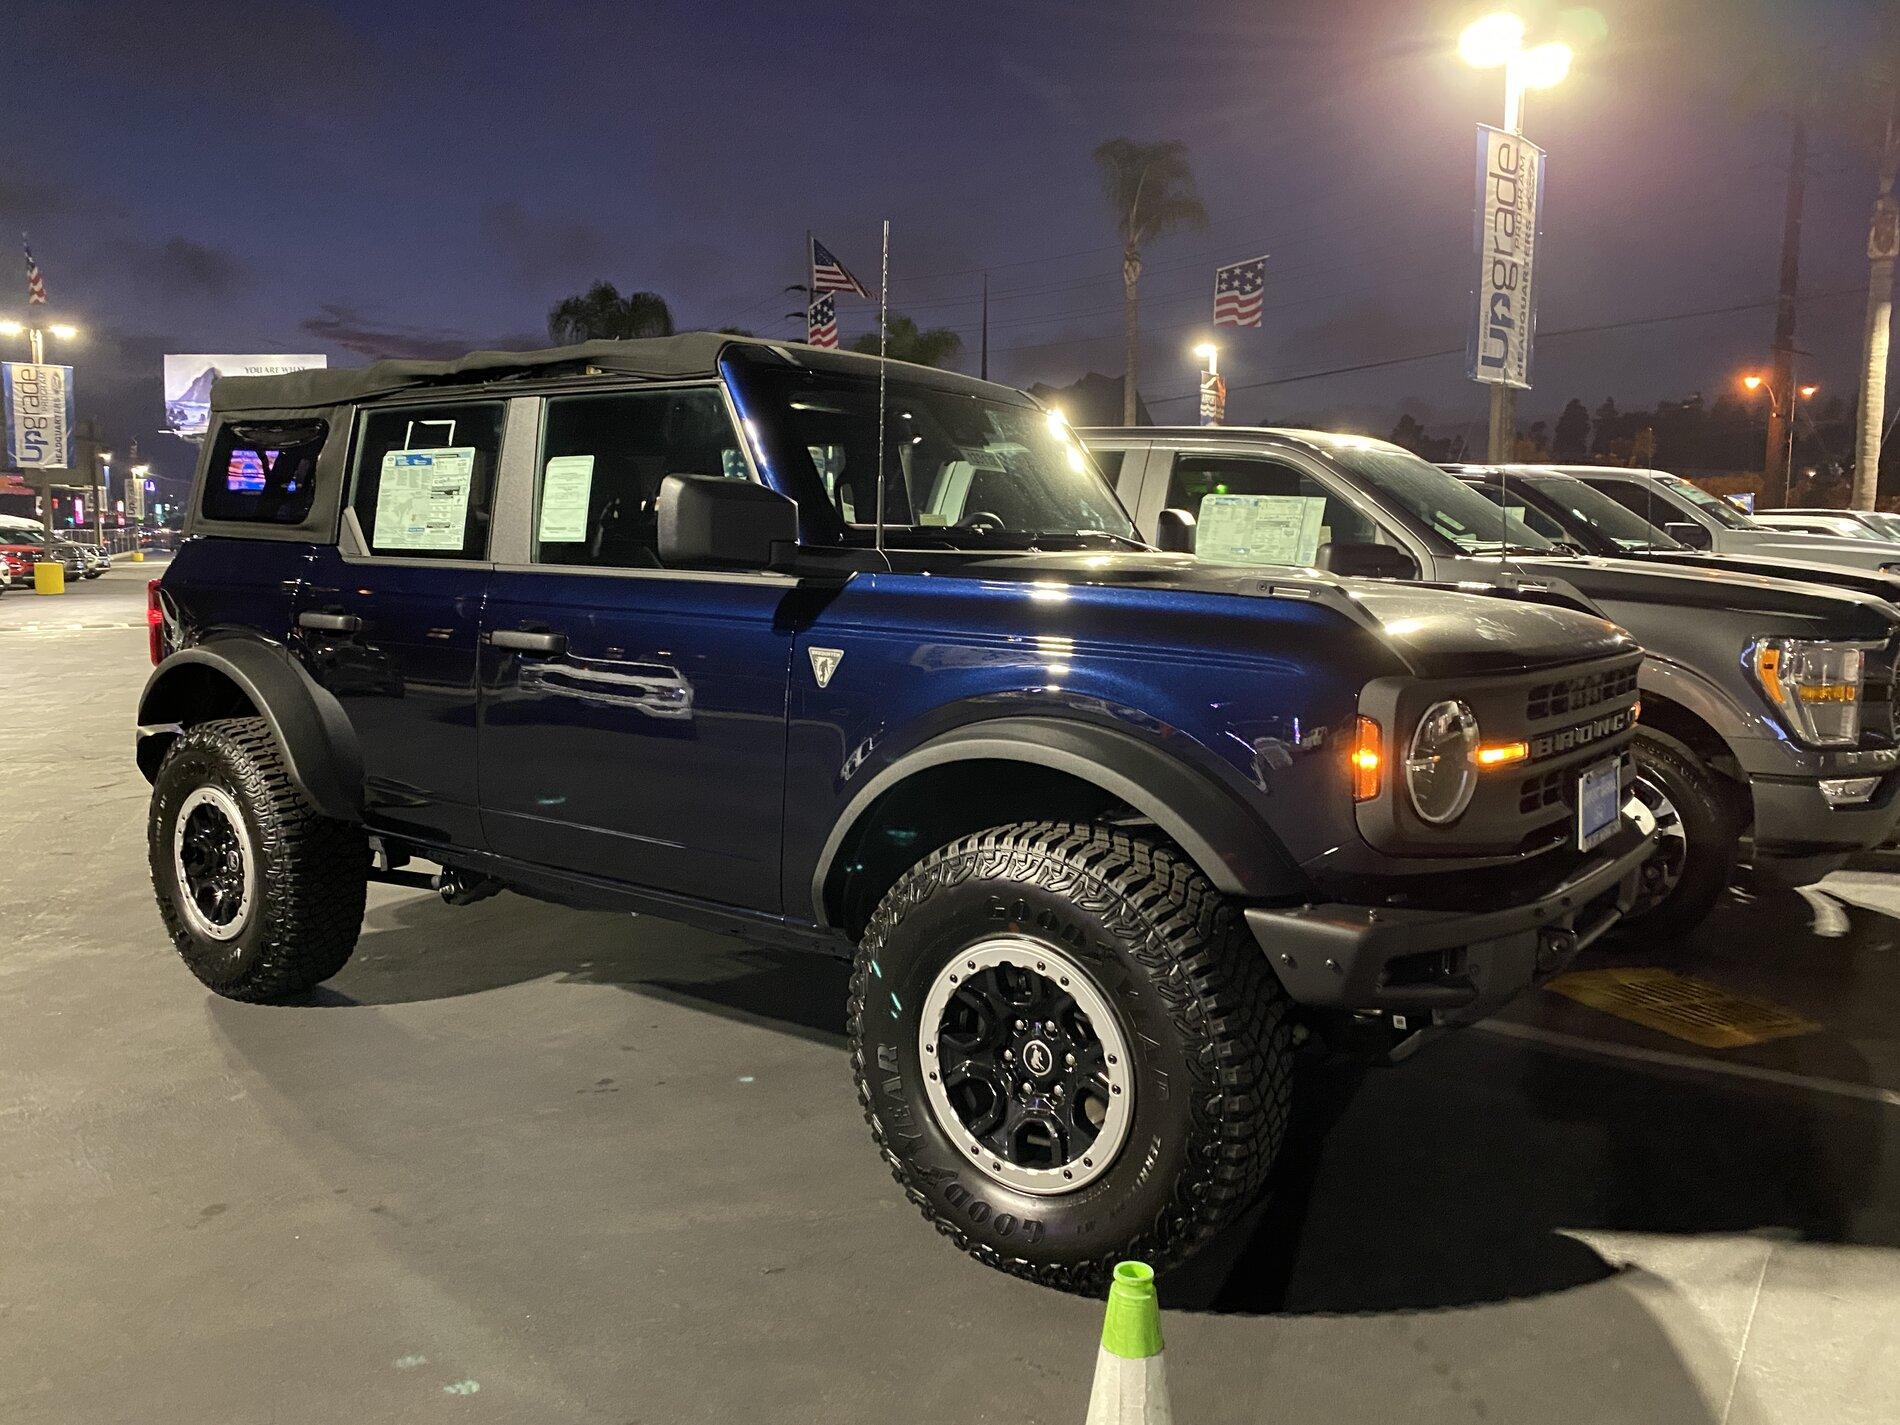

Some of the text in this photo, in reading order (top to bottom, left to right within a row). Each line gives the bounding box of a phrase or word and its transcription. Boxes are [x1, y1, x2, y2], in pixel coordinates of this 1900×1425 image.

[1515, 154, 1526, 250] PROGRAM
[1517, 220, 1532, 377] HEADQUARTERS
[244, 366, 262, 374] YOU
[264, 366, 279, 374] ARE
[53, 397, 63, 464] HEADQUARTERS
[1534, 710, 1635, 755] BRONCO
